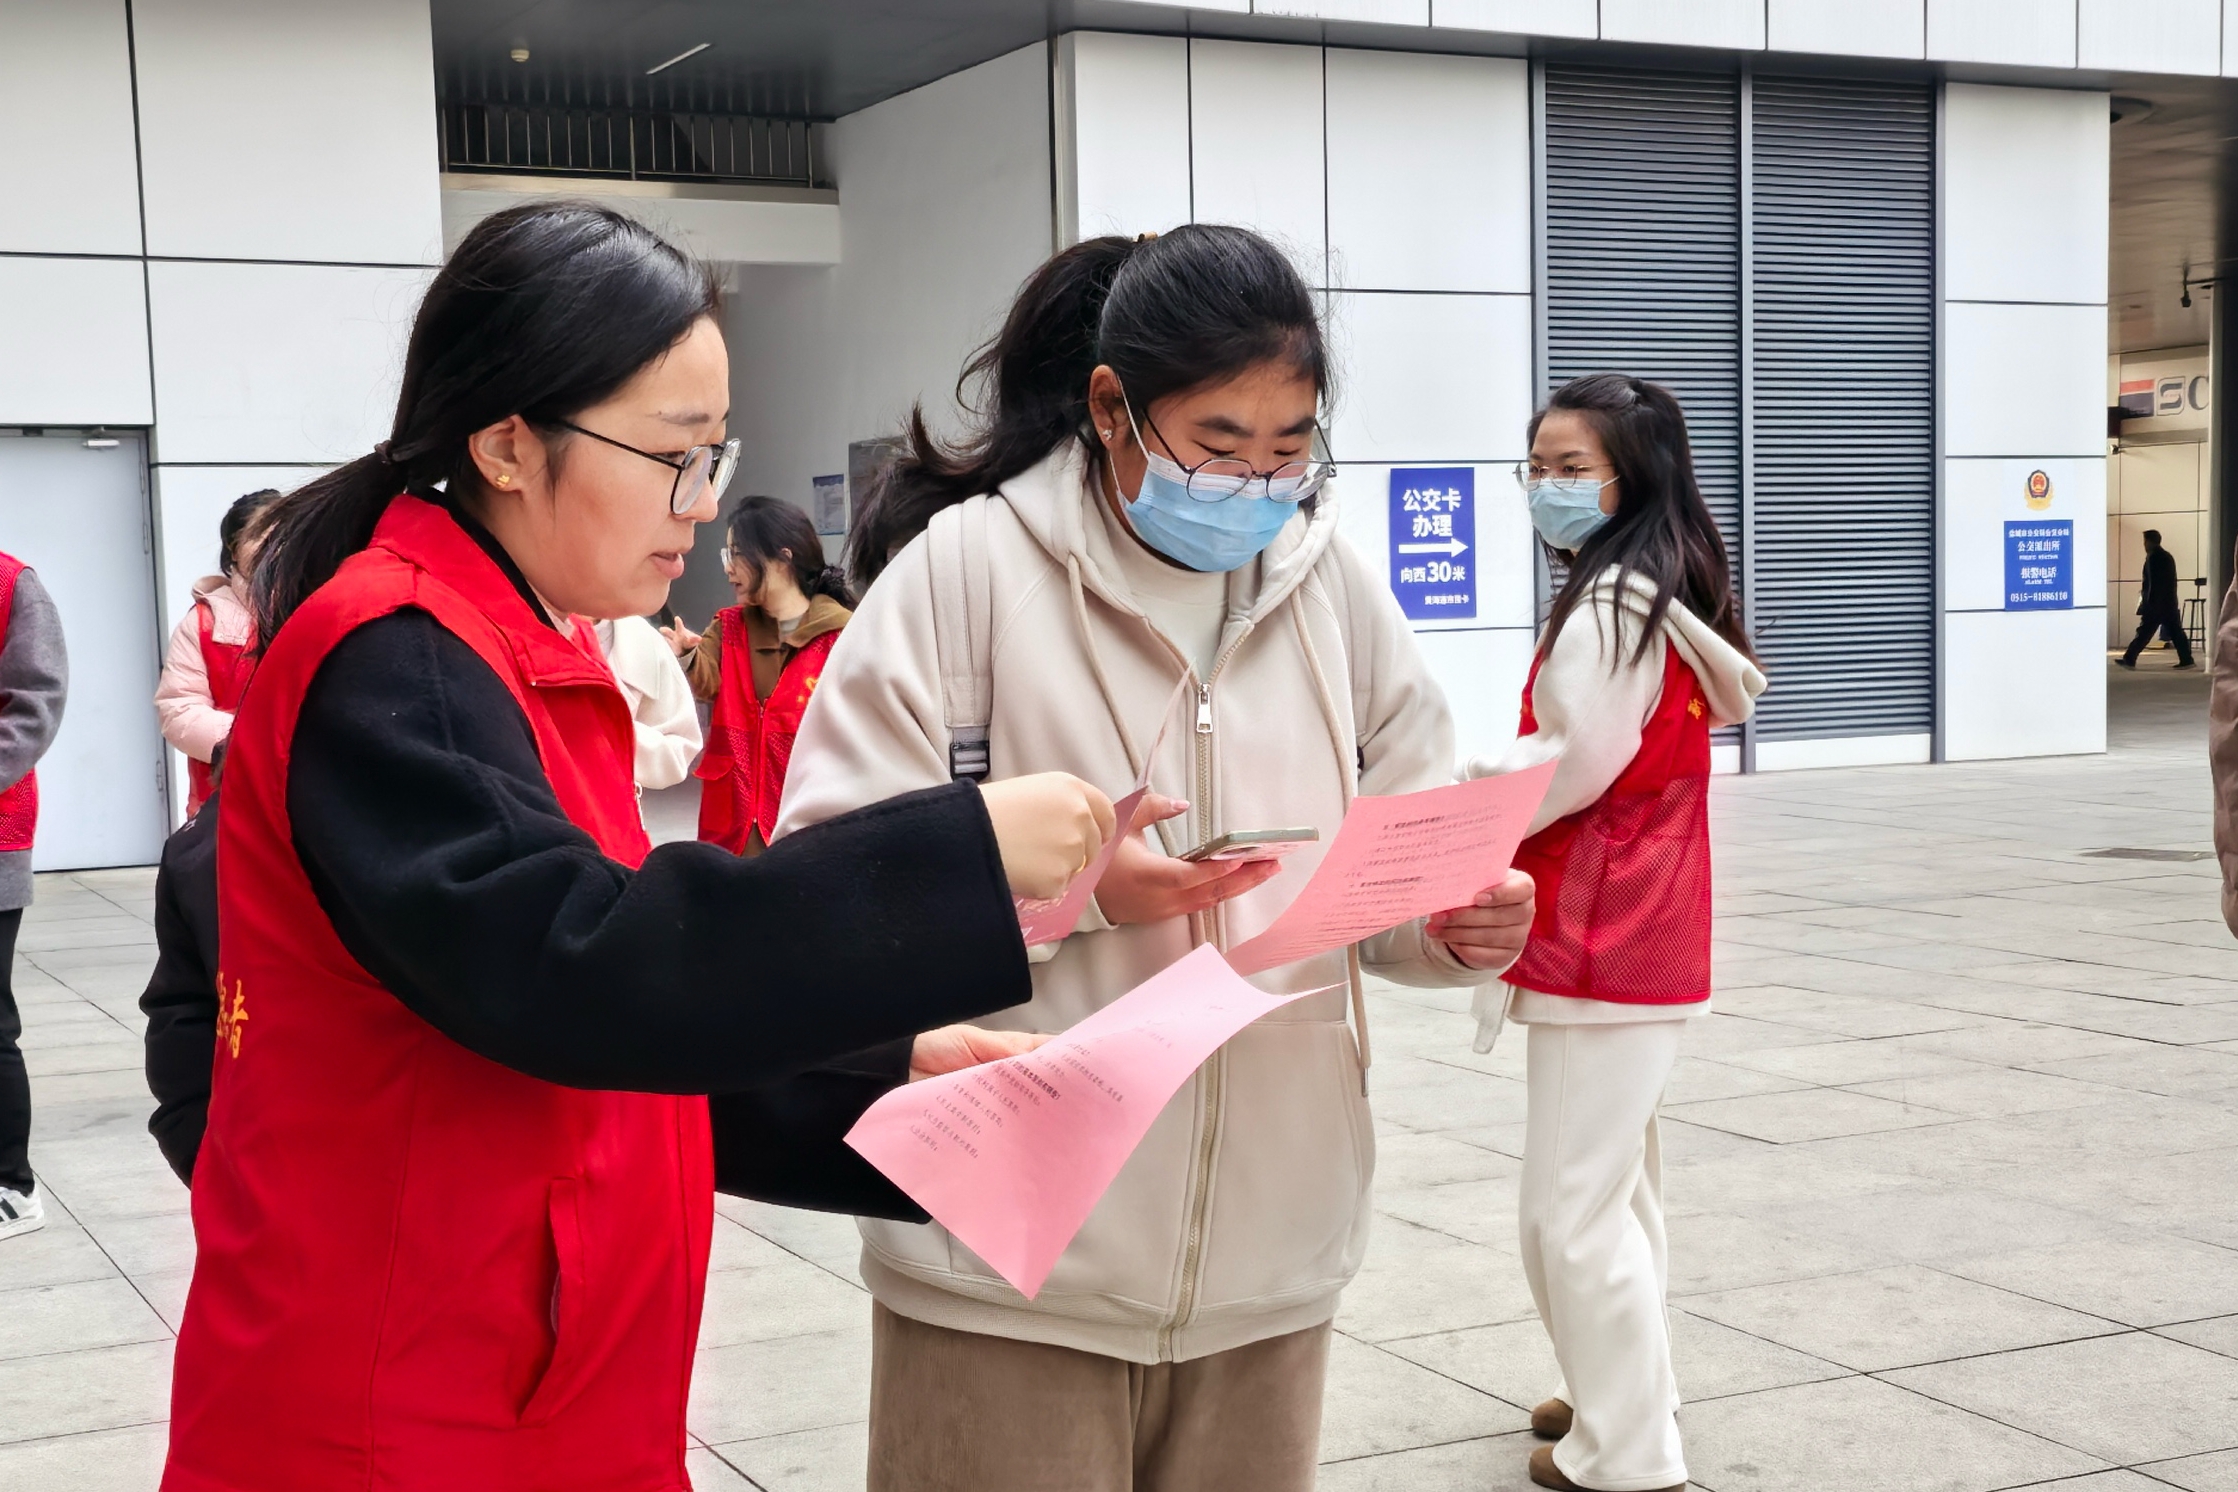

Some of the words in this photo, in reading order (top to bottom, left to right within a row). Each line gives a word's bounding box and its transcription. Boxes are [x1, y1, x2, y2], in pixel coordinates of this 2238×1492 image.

[1402, 488, 1461, 512] 公交卡
[1412, 514, 1453, 538] 办理
[2017, 540, 2061, 552] 公交派出所
[1400, 561, 1466, 583] 向西30米
[2020, 566, 2058, 579] 报警电话
